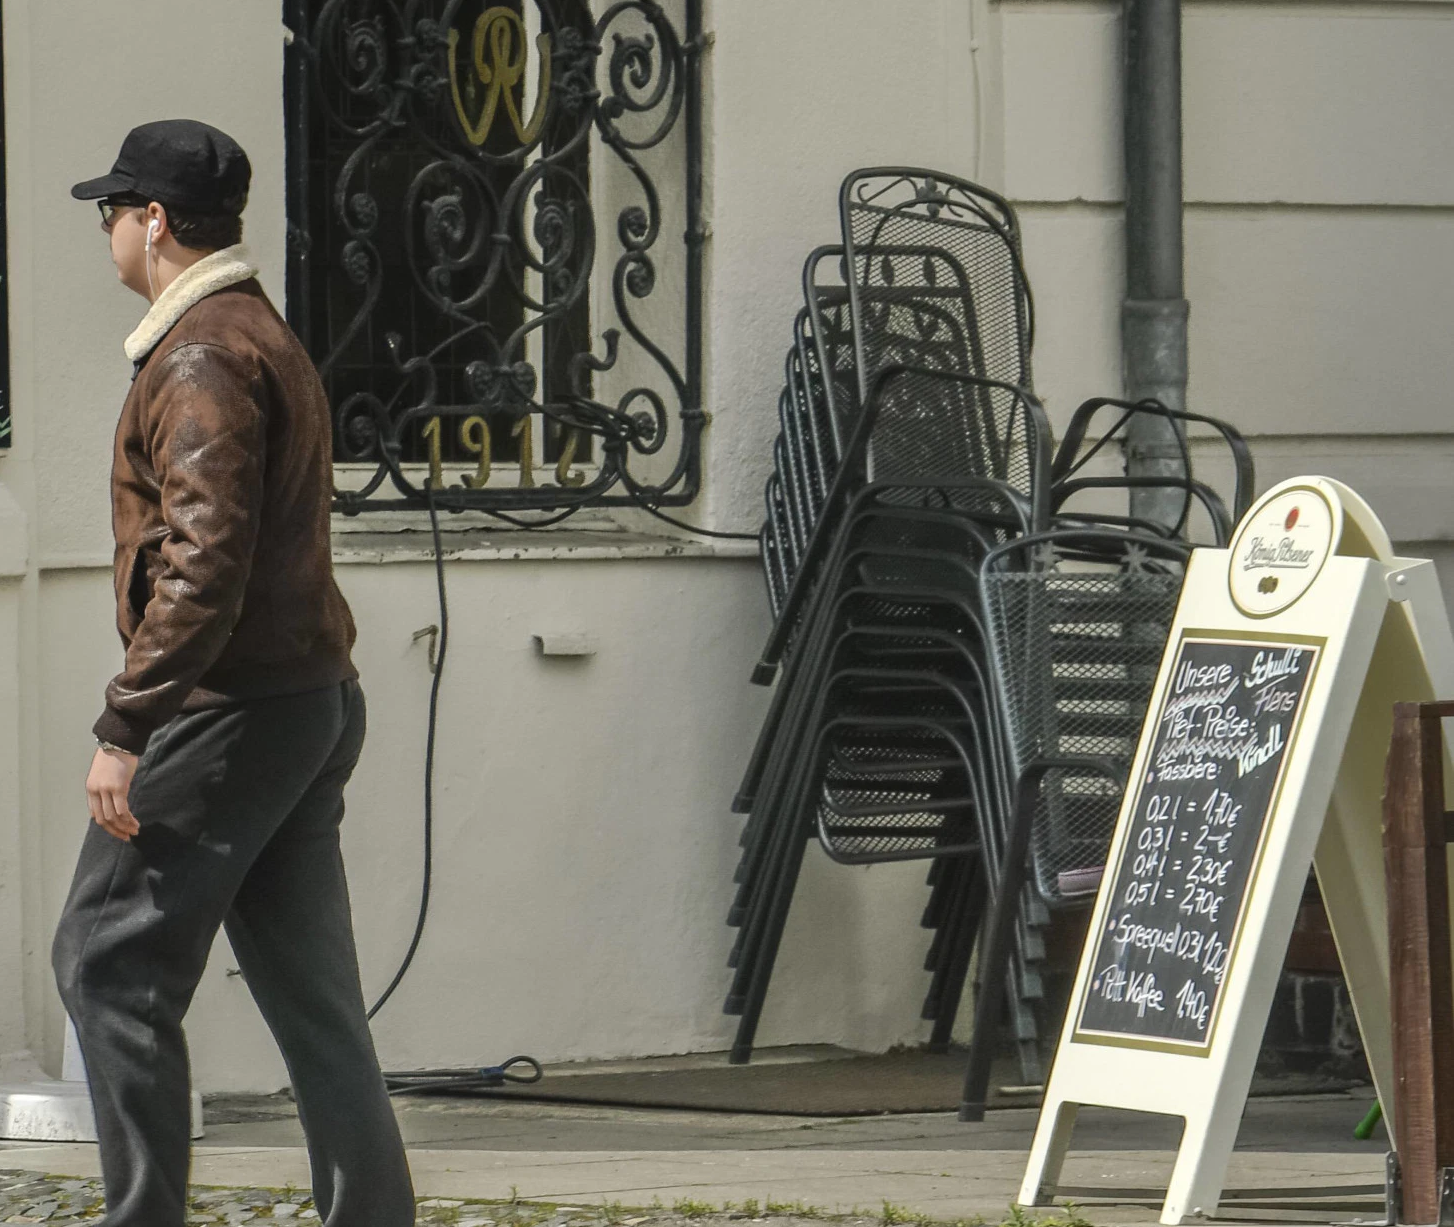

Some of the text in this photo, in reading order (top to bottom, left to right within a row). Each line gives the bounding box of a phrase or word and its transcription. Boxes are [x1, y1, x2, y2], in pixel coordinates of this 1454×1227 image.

[1175, 660, 1233, 694] Unsere
[1251, 675, 1297, 717] Flens
[1238, 723, 1284, 779] Kindl
